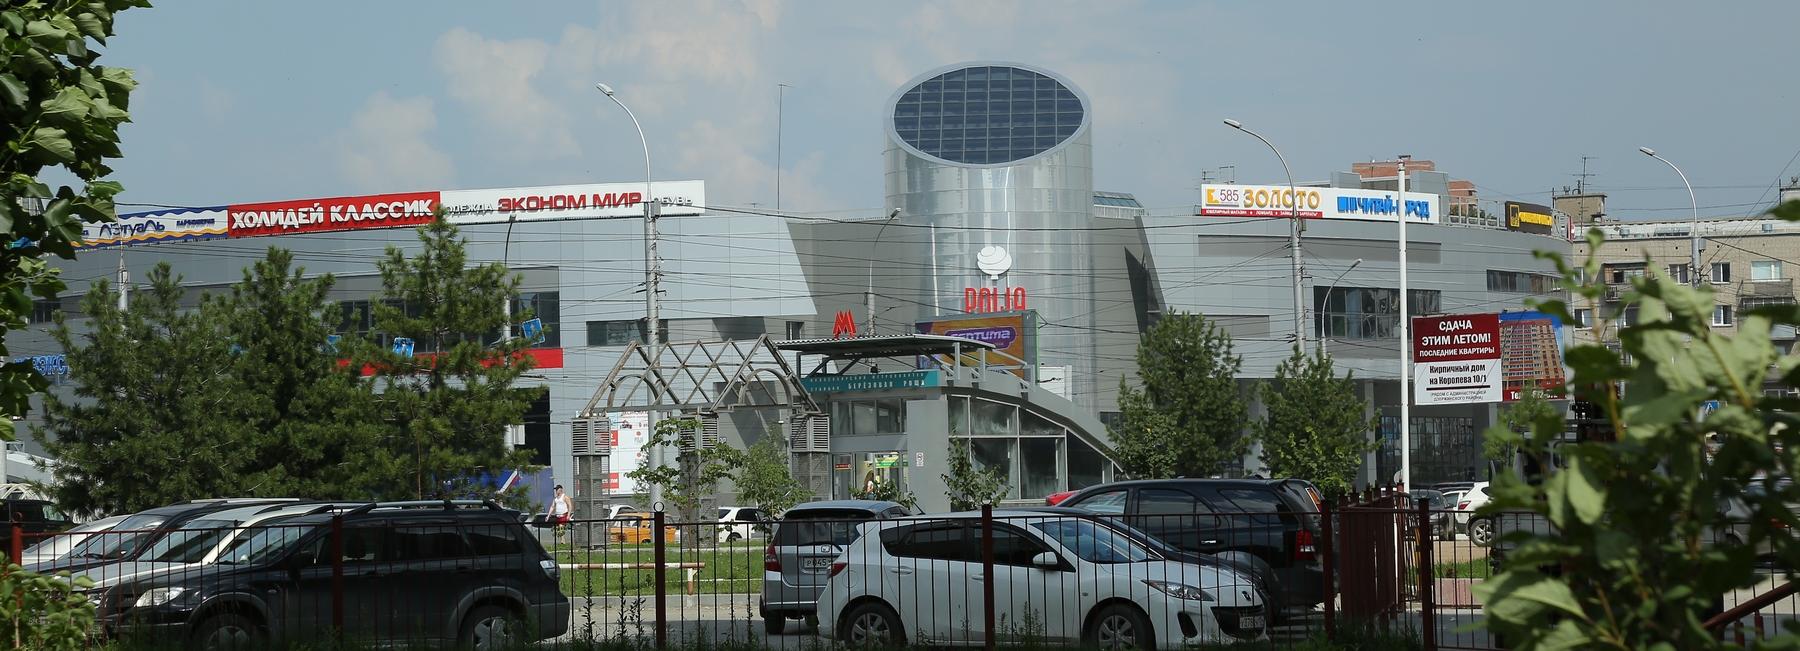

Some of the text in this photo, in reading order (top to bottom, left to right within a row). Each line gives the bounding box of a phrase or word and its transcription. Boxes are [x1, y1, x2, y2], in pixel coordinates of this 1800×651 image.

[498, 192, 642, 212] ЭКОНОМ МИР
[1220, 189, 1321, 209] 585 ЗОЛОТО
[231, 199, 435, 230] ХОЛИДЕЙ КЛАССИК
[1439, 320, 1473, 332] СДАЧА
[1422, 333, 1491, 346] ЭТИМ ЛЕТОМ!
[1419, 346, 1495, 358] ПОСЛЕДНИЕ КВАРТИРЫ
[1429, 364, 1485, 374] Кирпичный дом
[1429, 374, 1487, 385] на Королева 10/1
